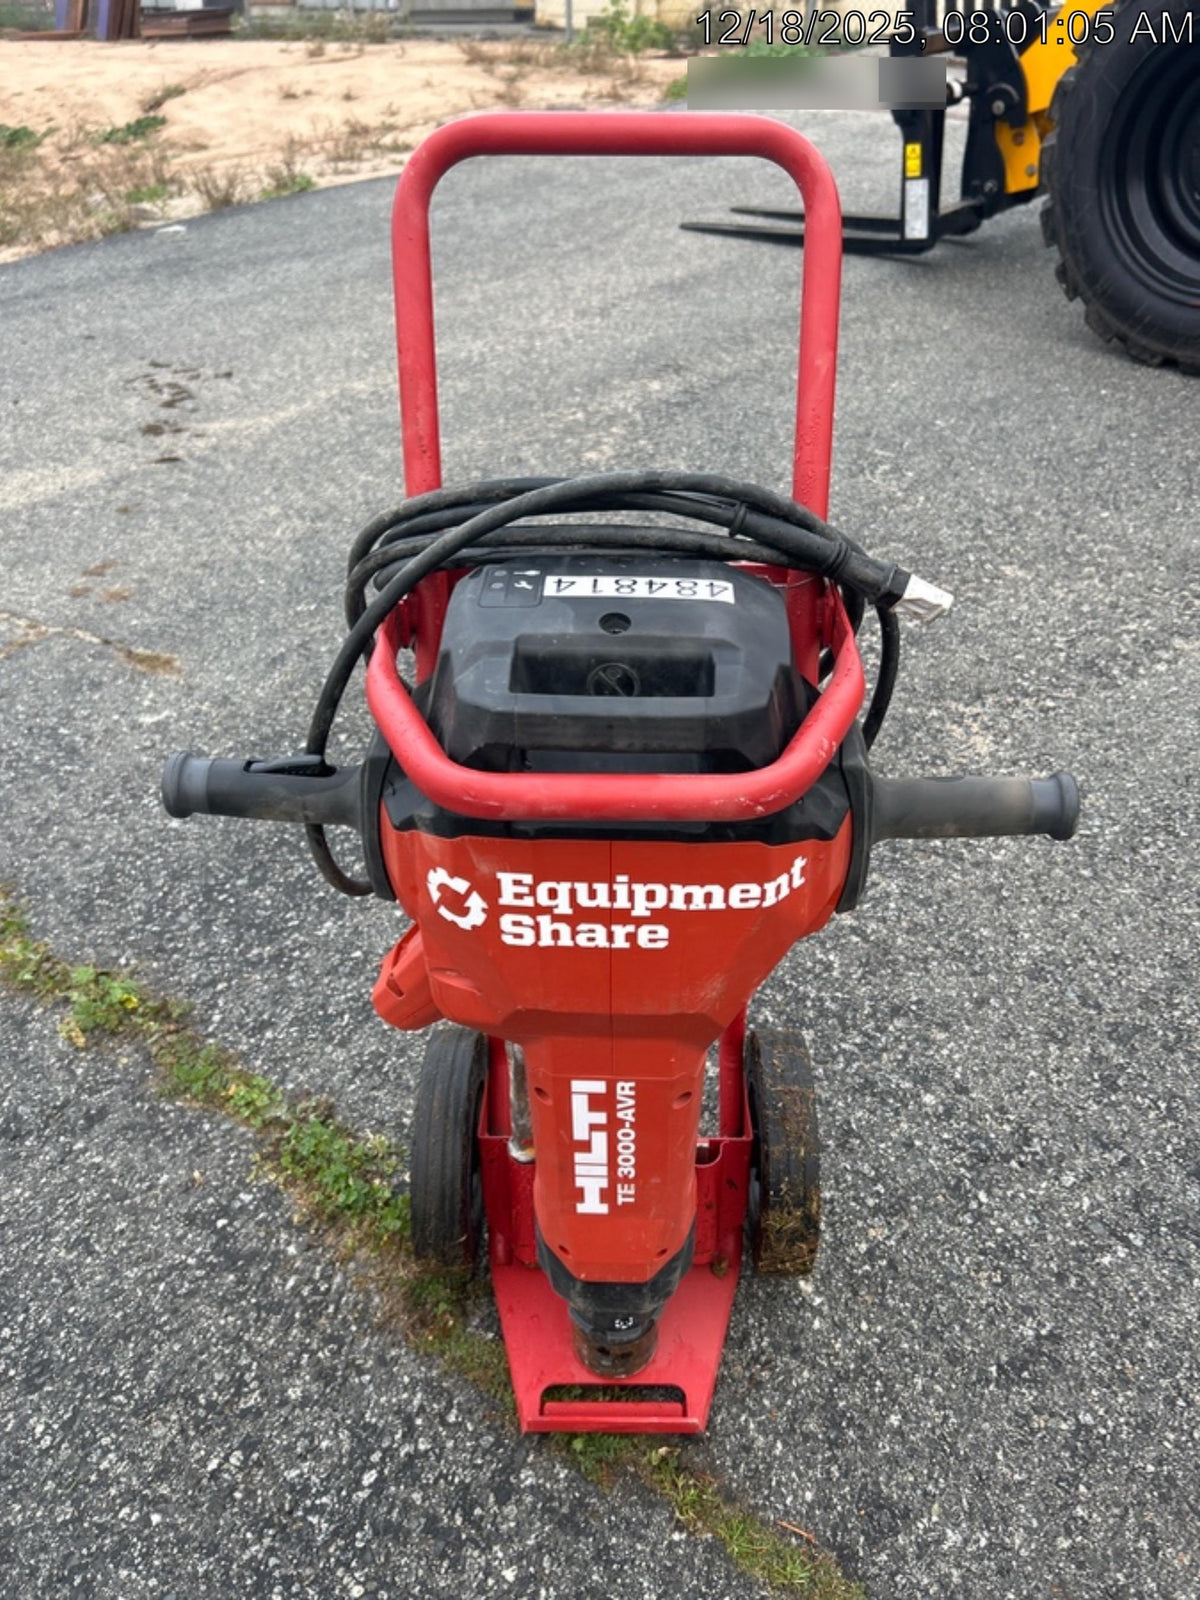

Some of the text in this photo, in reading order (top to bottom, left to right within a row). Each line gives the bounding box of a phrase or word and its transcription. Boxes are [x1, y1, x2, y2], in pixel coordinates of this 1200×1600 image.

[553, 577, 729, 598] 484814
[496, 856, 808, 917] Equipment
[500, 914, 669, 949] Share
[570, 1079, 609, 1215] HILTI
[615, 1081, 636, 1206] TE 3000-AVR
